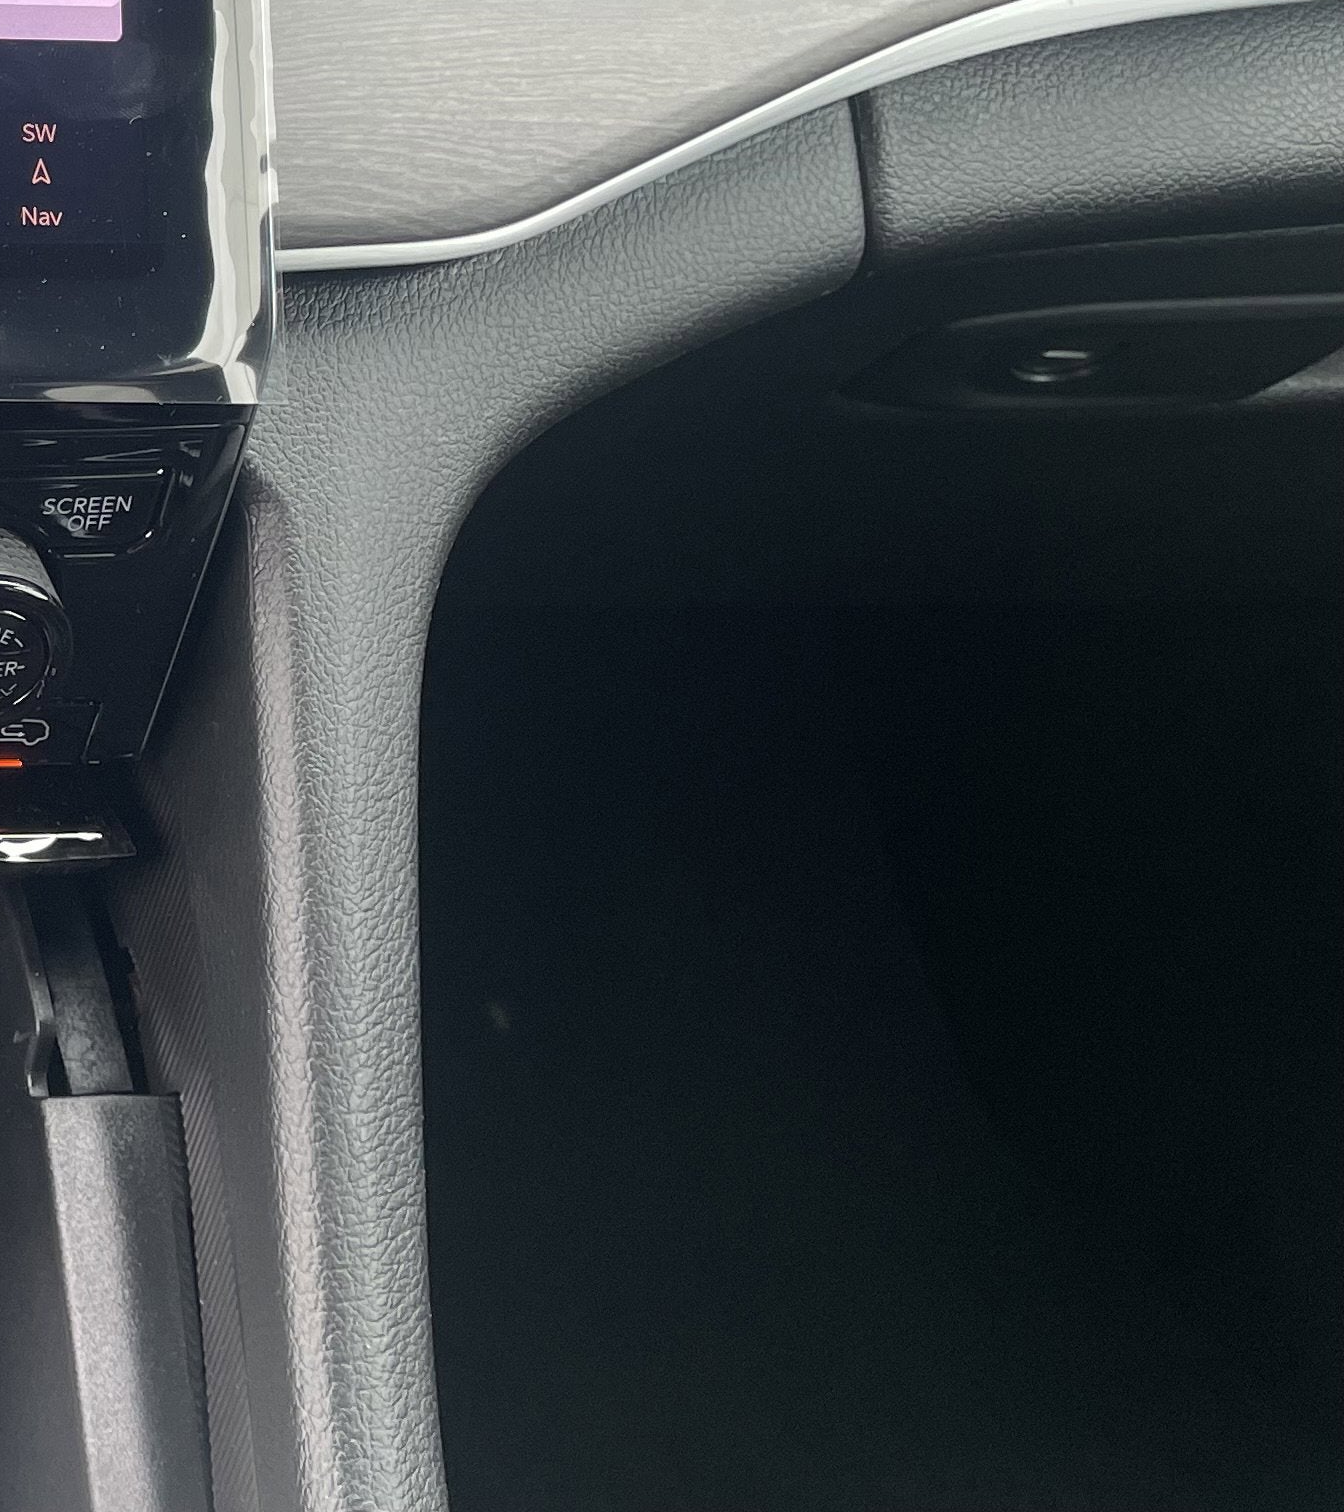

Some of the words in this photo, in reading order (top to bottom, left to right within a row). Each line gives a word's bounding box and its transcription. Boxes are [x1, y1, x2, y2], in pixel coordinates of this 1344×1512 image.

[21, 122, 58, 144] SW
[20, 205, 64, 227] Nav
[42, 495, 133, 517] SCREEN
[66, 513, 113, 533] OFF
